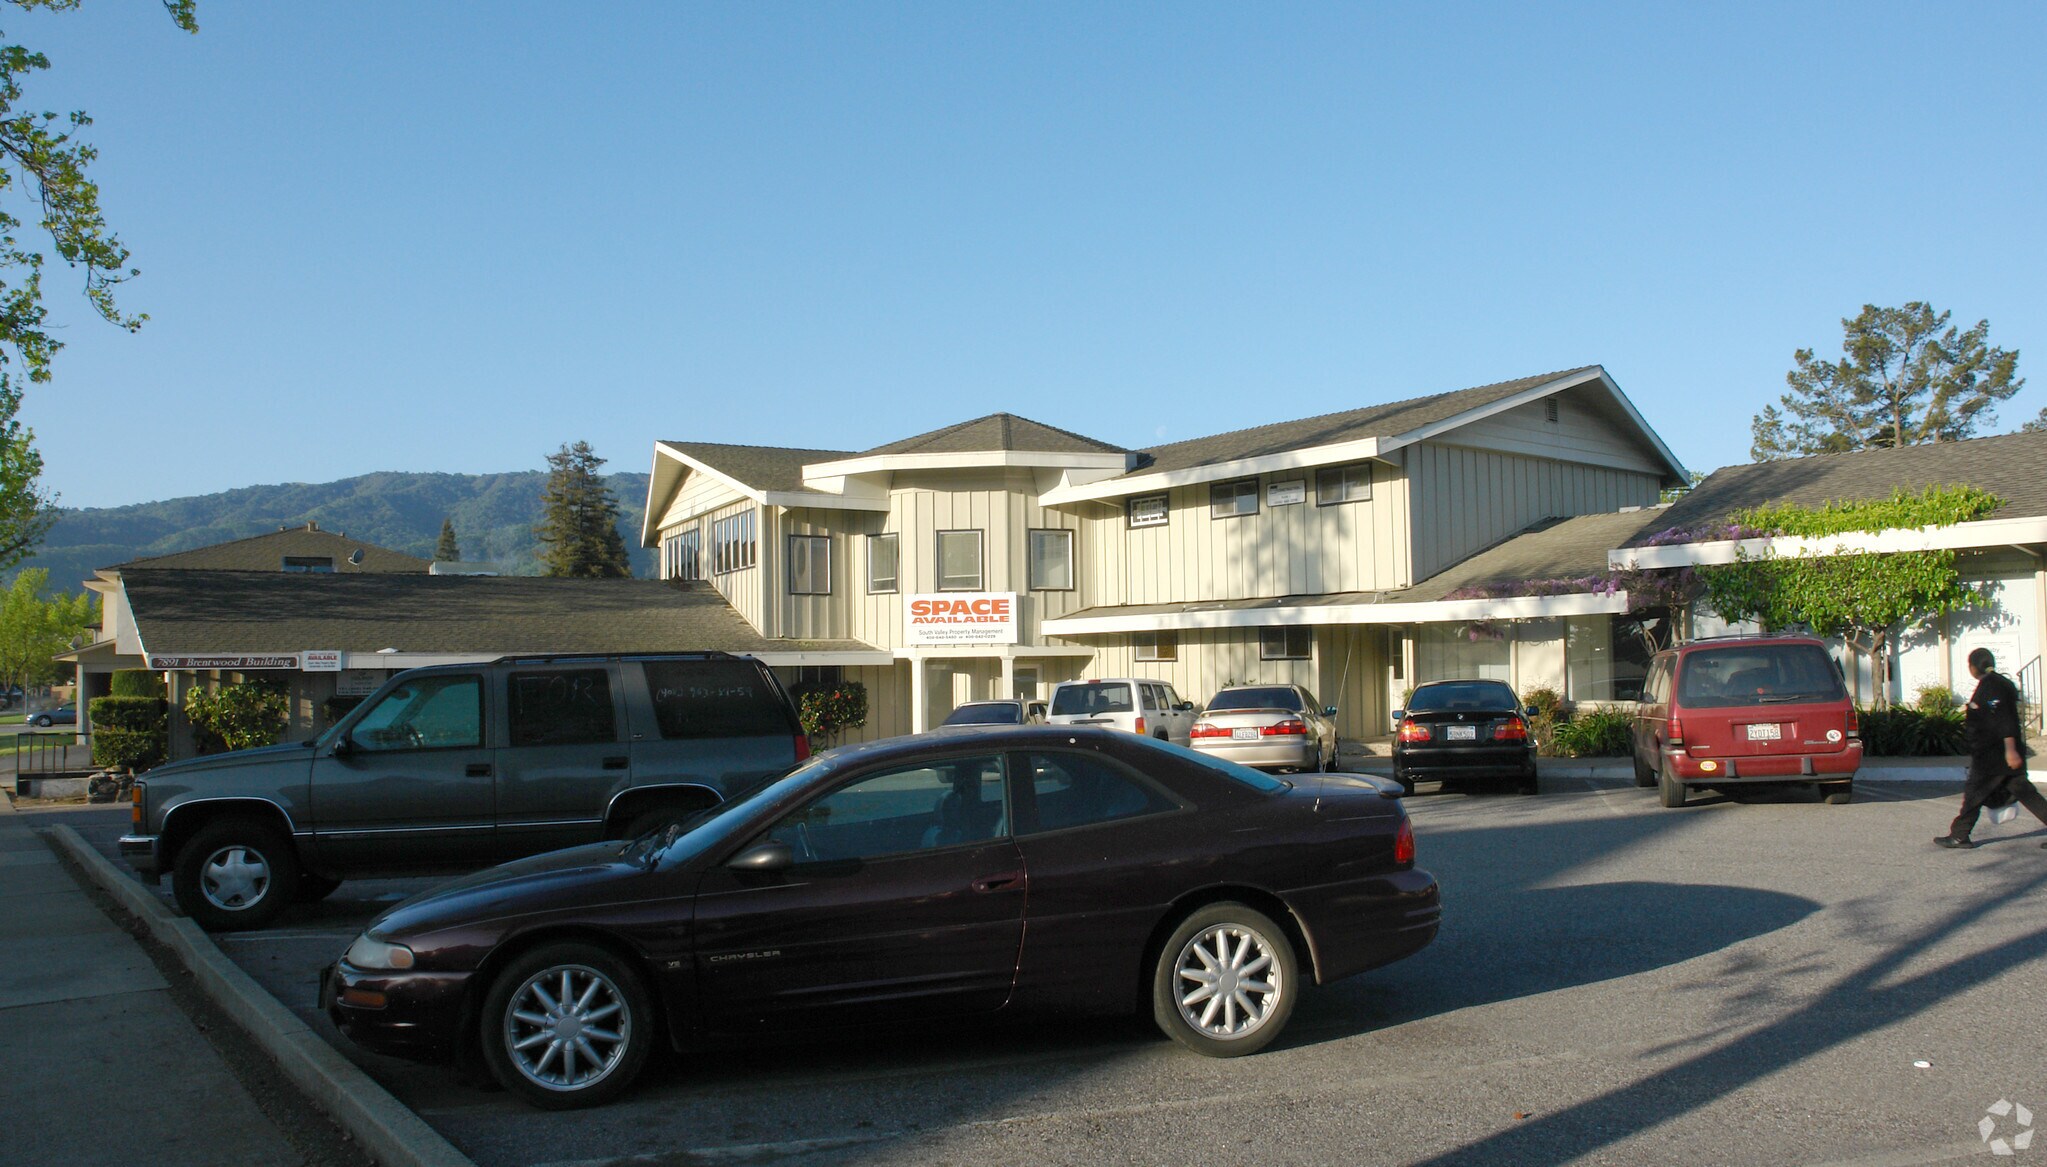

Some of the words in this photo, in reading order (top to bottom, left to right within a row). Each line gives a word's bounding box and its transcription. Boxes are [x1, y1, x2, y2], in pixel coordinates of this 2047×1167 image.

[911, 599, 1010, 616] SPACE
[912, 615, 1010, 624] AVAILABLE
[157, 658, 179, 667] 7891
[186, 658, 241, 667] Brentwood
[245, 657, 291, 668] Building
[710, 950, 781, 962] CHRYSLER
